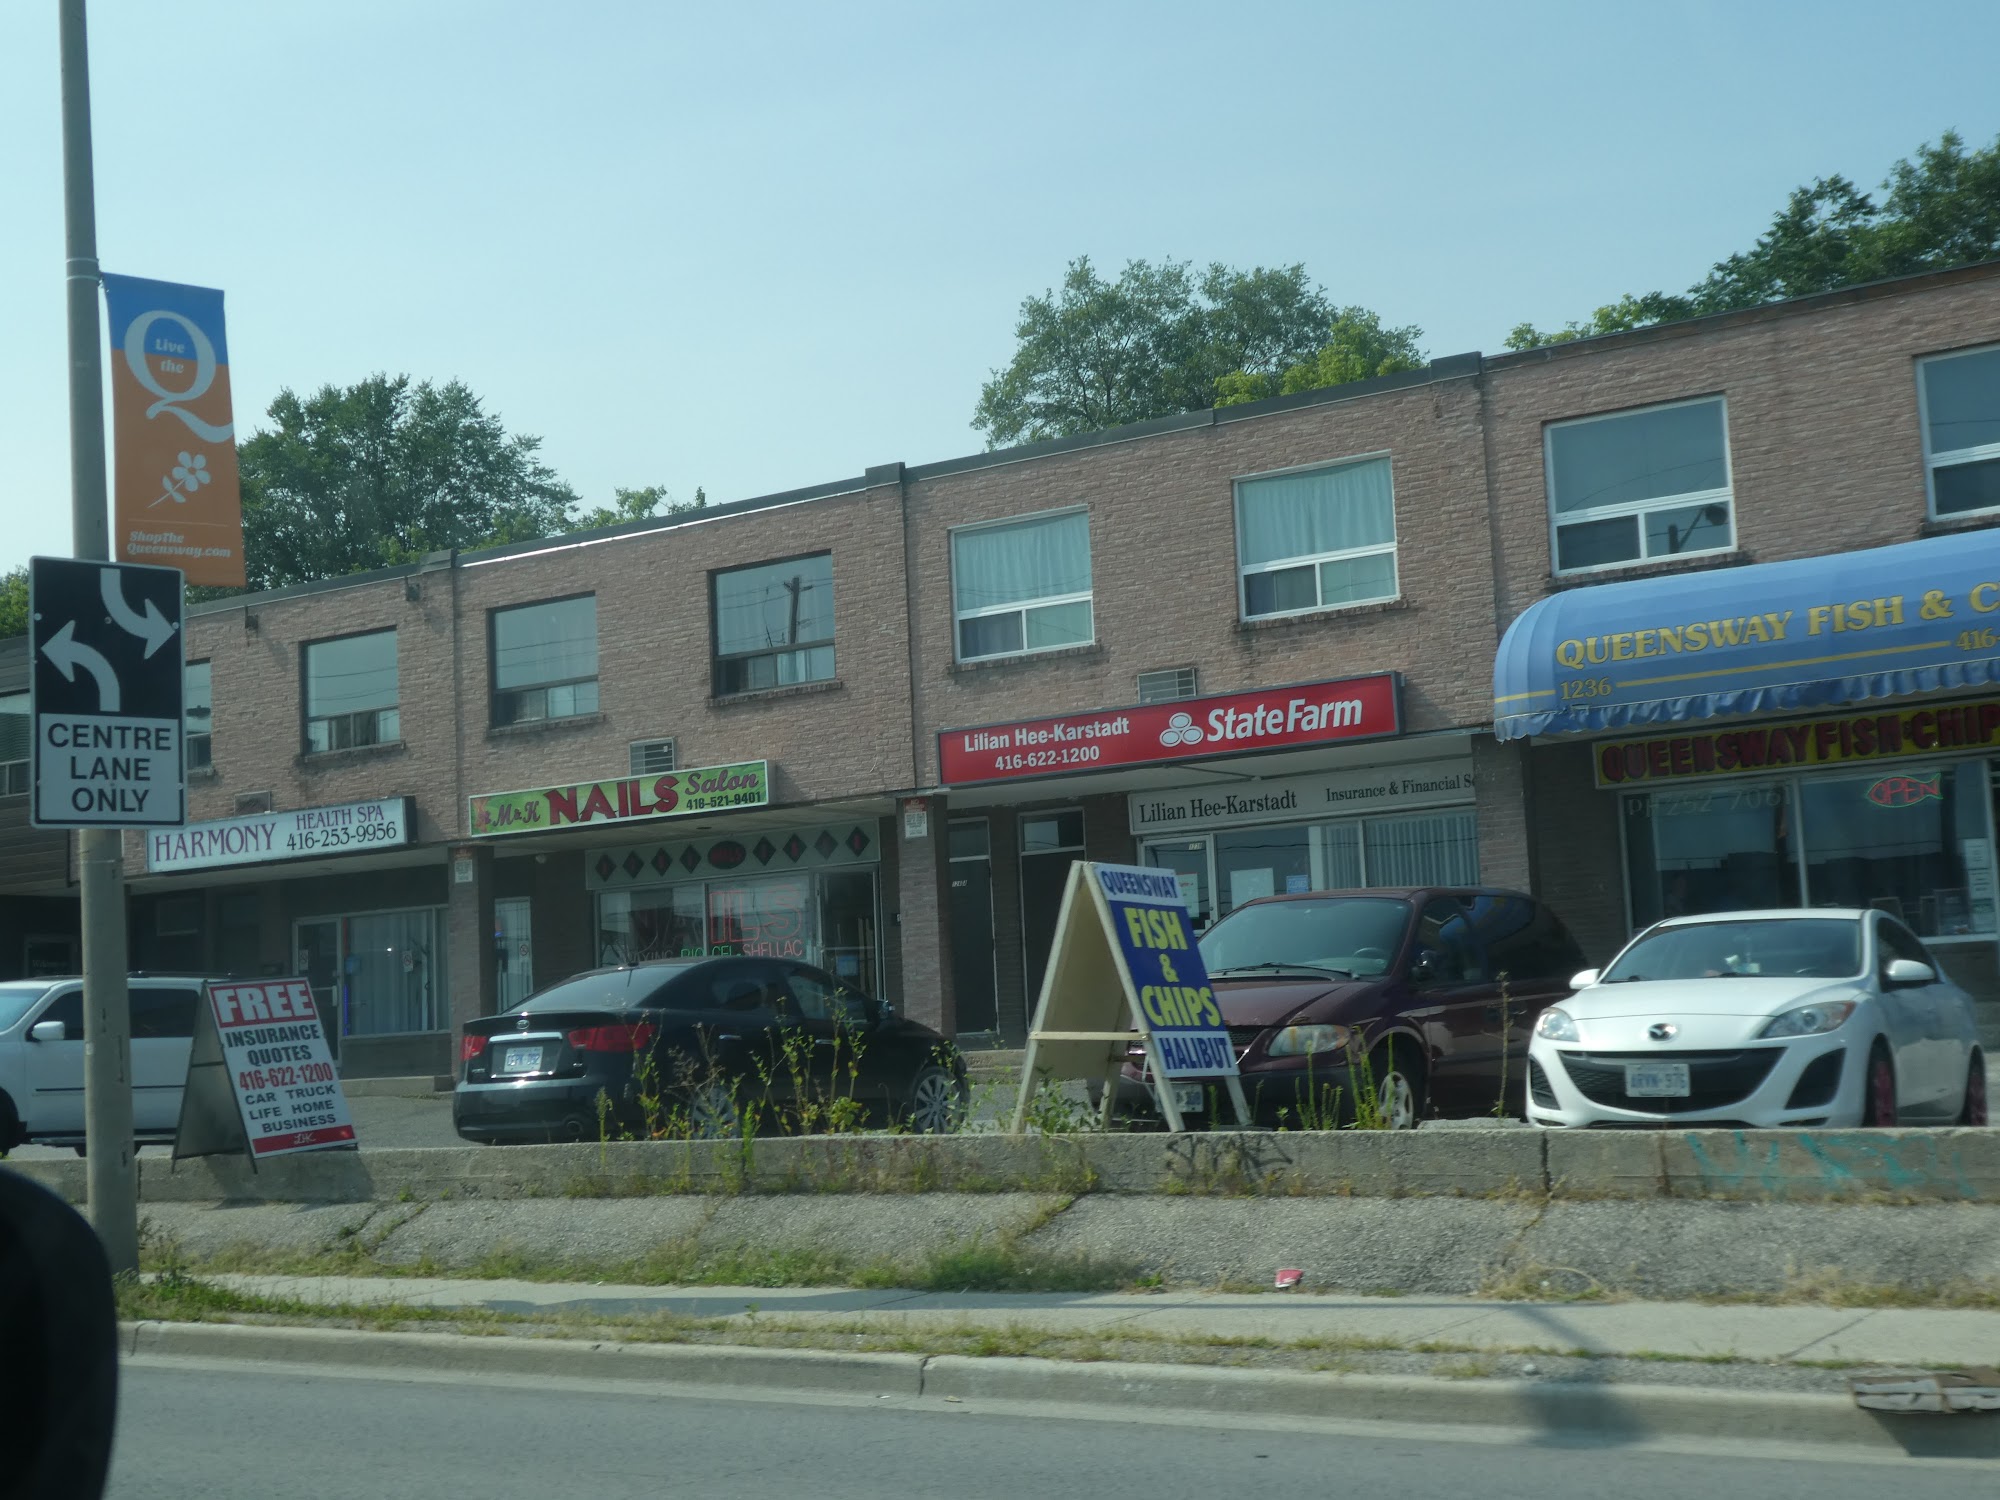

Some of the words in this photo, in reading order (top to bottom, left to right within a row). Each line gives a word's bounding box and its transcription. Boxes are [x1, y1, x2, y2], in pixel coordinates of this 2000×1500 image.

[155, 338, 185, 354] Live
[124, 310, 235, 444] Q
[160, 359, 184, 374] the
[126, 542, 232, 559] Queensway.com
[1556, 610, 1792, 670] QUEENSWAY
[1808, 595, 1904, 635] FISH
[1920, 589, 1953, 620] &
[1560, 677, 1613, 701] 1236
[47, 722, 172, 752] CENTRE
[964, 730, 1010, 752] Lilian
[1014, 717, 1129, 746] Hee-Karstadt
[995, 746, 1100, 771] 416-622-1200
[1602, 724, 1812, 783] QUEENSWAY
[1815, 715, 1903, 761] FISH
[70, 756, 151, 782] LANE
[685, 769, 759, 797] Salon
[71, 786, 149, 814] ONLY
[543, 776, 680, 826] NAILS
[1326, 785, 1386, 802] Insurance
[1389, 782, 1399, 795] &
[1402, 776, 1460, 794] Financial
[1869, 777, 1940, 805] OPEN
[296, 808, 352, 831] HEALTH
[357, 804, 385, 824] SPA
[1139, 800, 1187, 823] Lilian
[1191, 790, 1297, 819] Hee-Karstadt
[155, 822, 276, 862] HARMONY
[286, 821, 398, 851] 416-253-9956
[1101, 870, 1178, 899] QUEENSWAY
[1123, 907, 1188, 950] FISH
[1159, 954, 1179, 983] &
[214, 983, 315, 1024] FREE
[1141, 985, 1221, 1027] CHIPS
[225, 1024, 320, 1048] INSURANCE
[247, 1045, 312, 1067] QUOTES
[1158, 1037, 1233, 1070] HALIBUT
[239, 1062, 334, 1091] 416-622-1200
[245, 1092, 277, 1105] CAR
[286, 1085, 336, 1100] TRUCK
[249, 1106, 282, 1120] LIFE
[292, 1099, 334, 1115] HOME
[262, 1113, 336, 1133] BUSINESS
